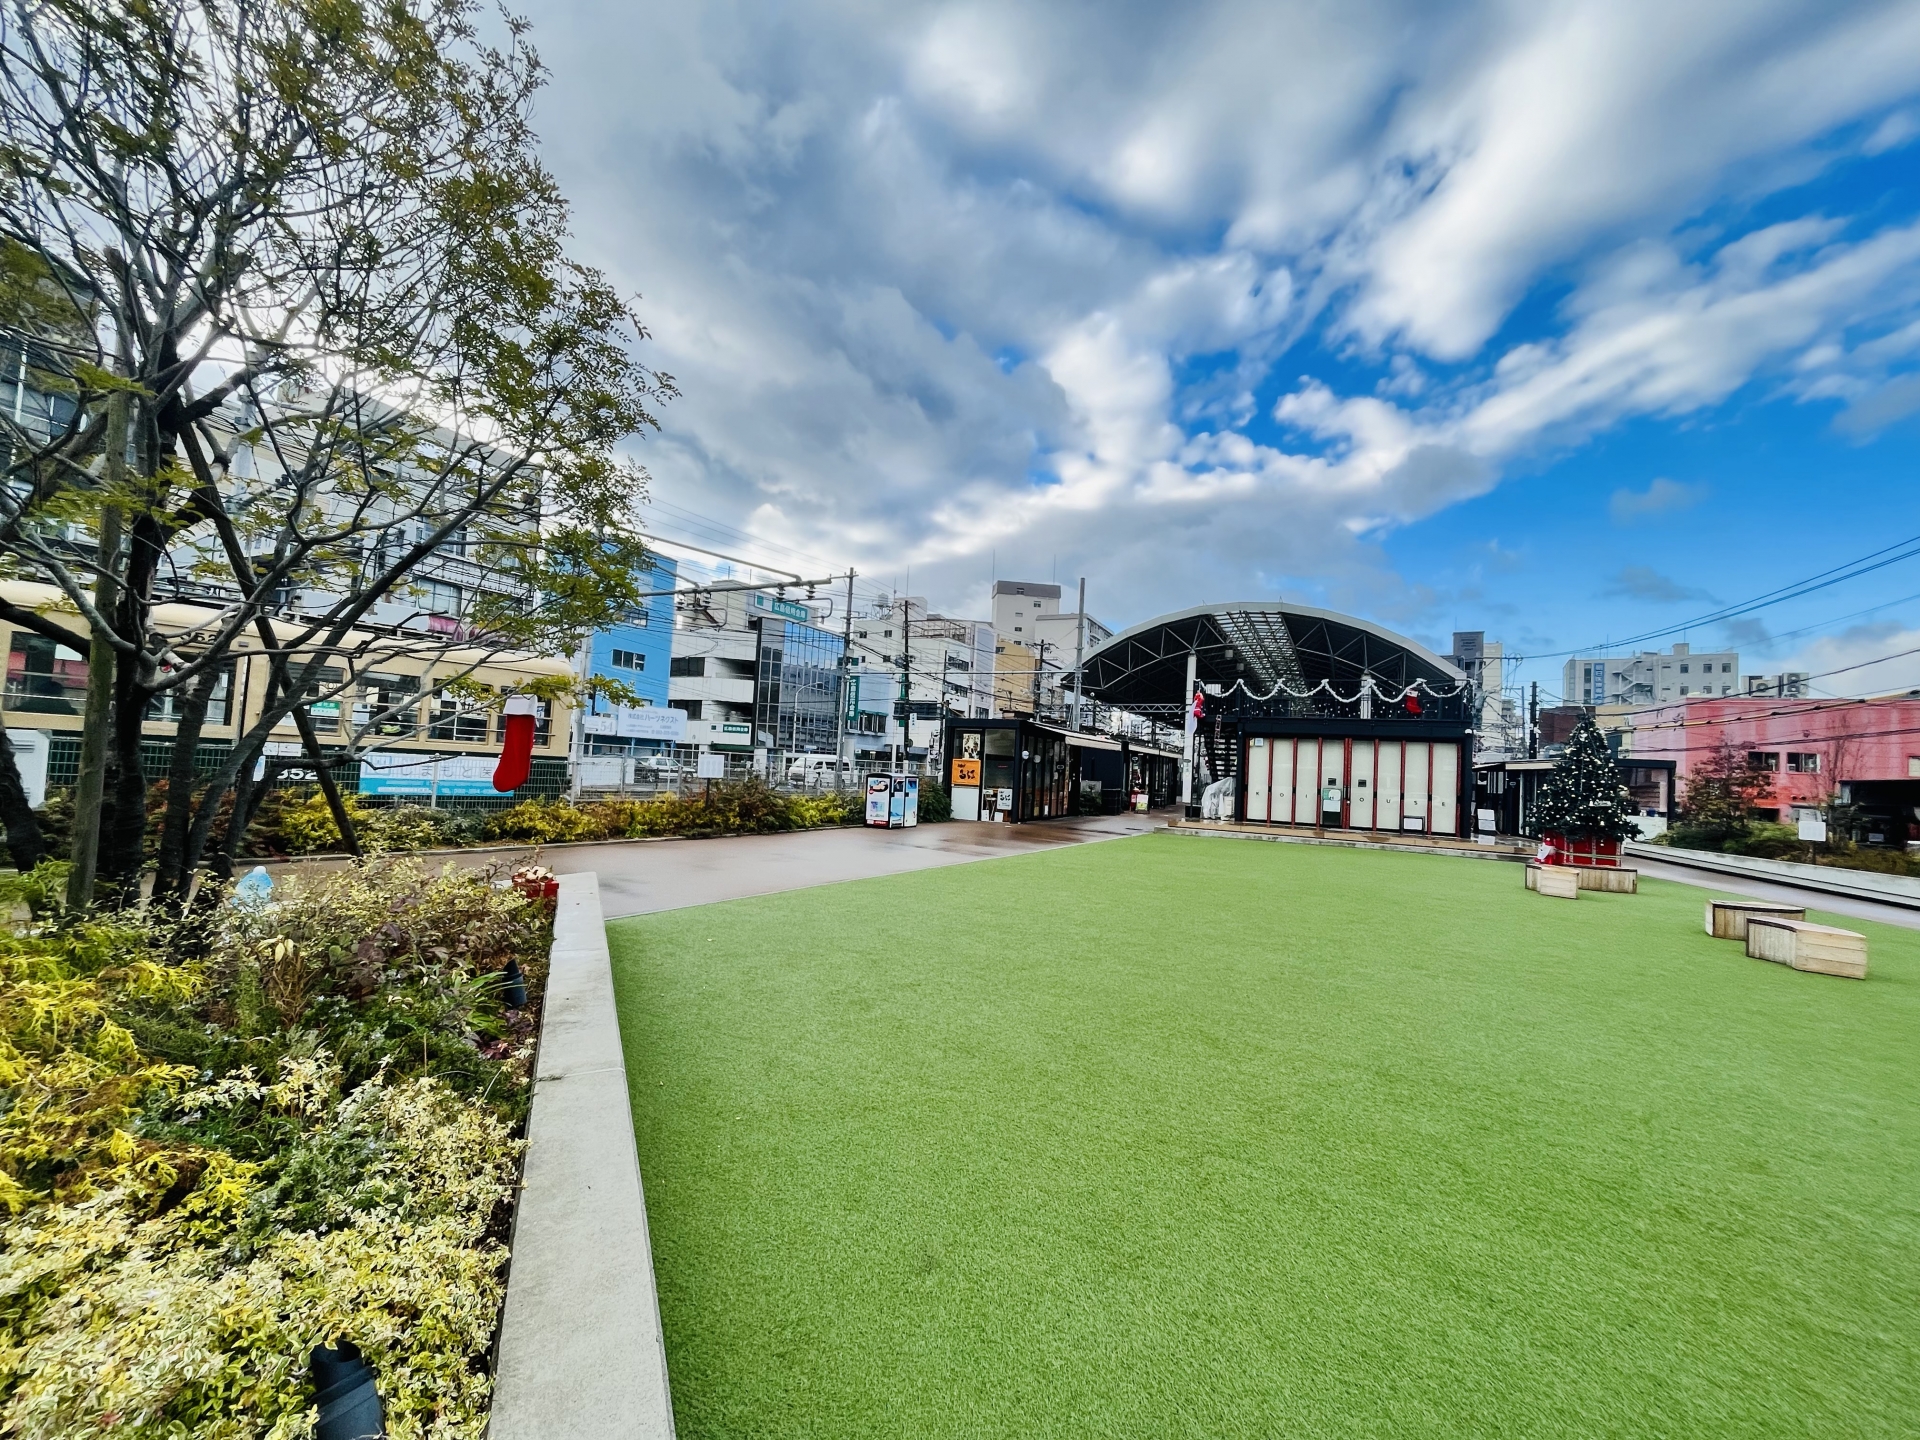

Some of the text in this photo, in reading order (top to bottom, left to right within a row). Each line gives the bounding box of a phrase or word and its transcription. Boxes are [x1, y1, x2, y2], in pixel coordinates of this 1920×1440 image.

[399, 764, 494, 780] しまもと医
